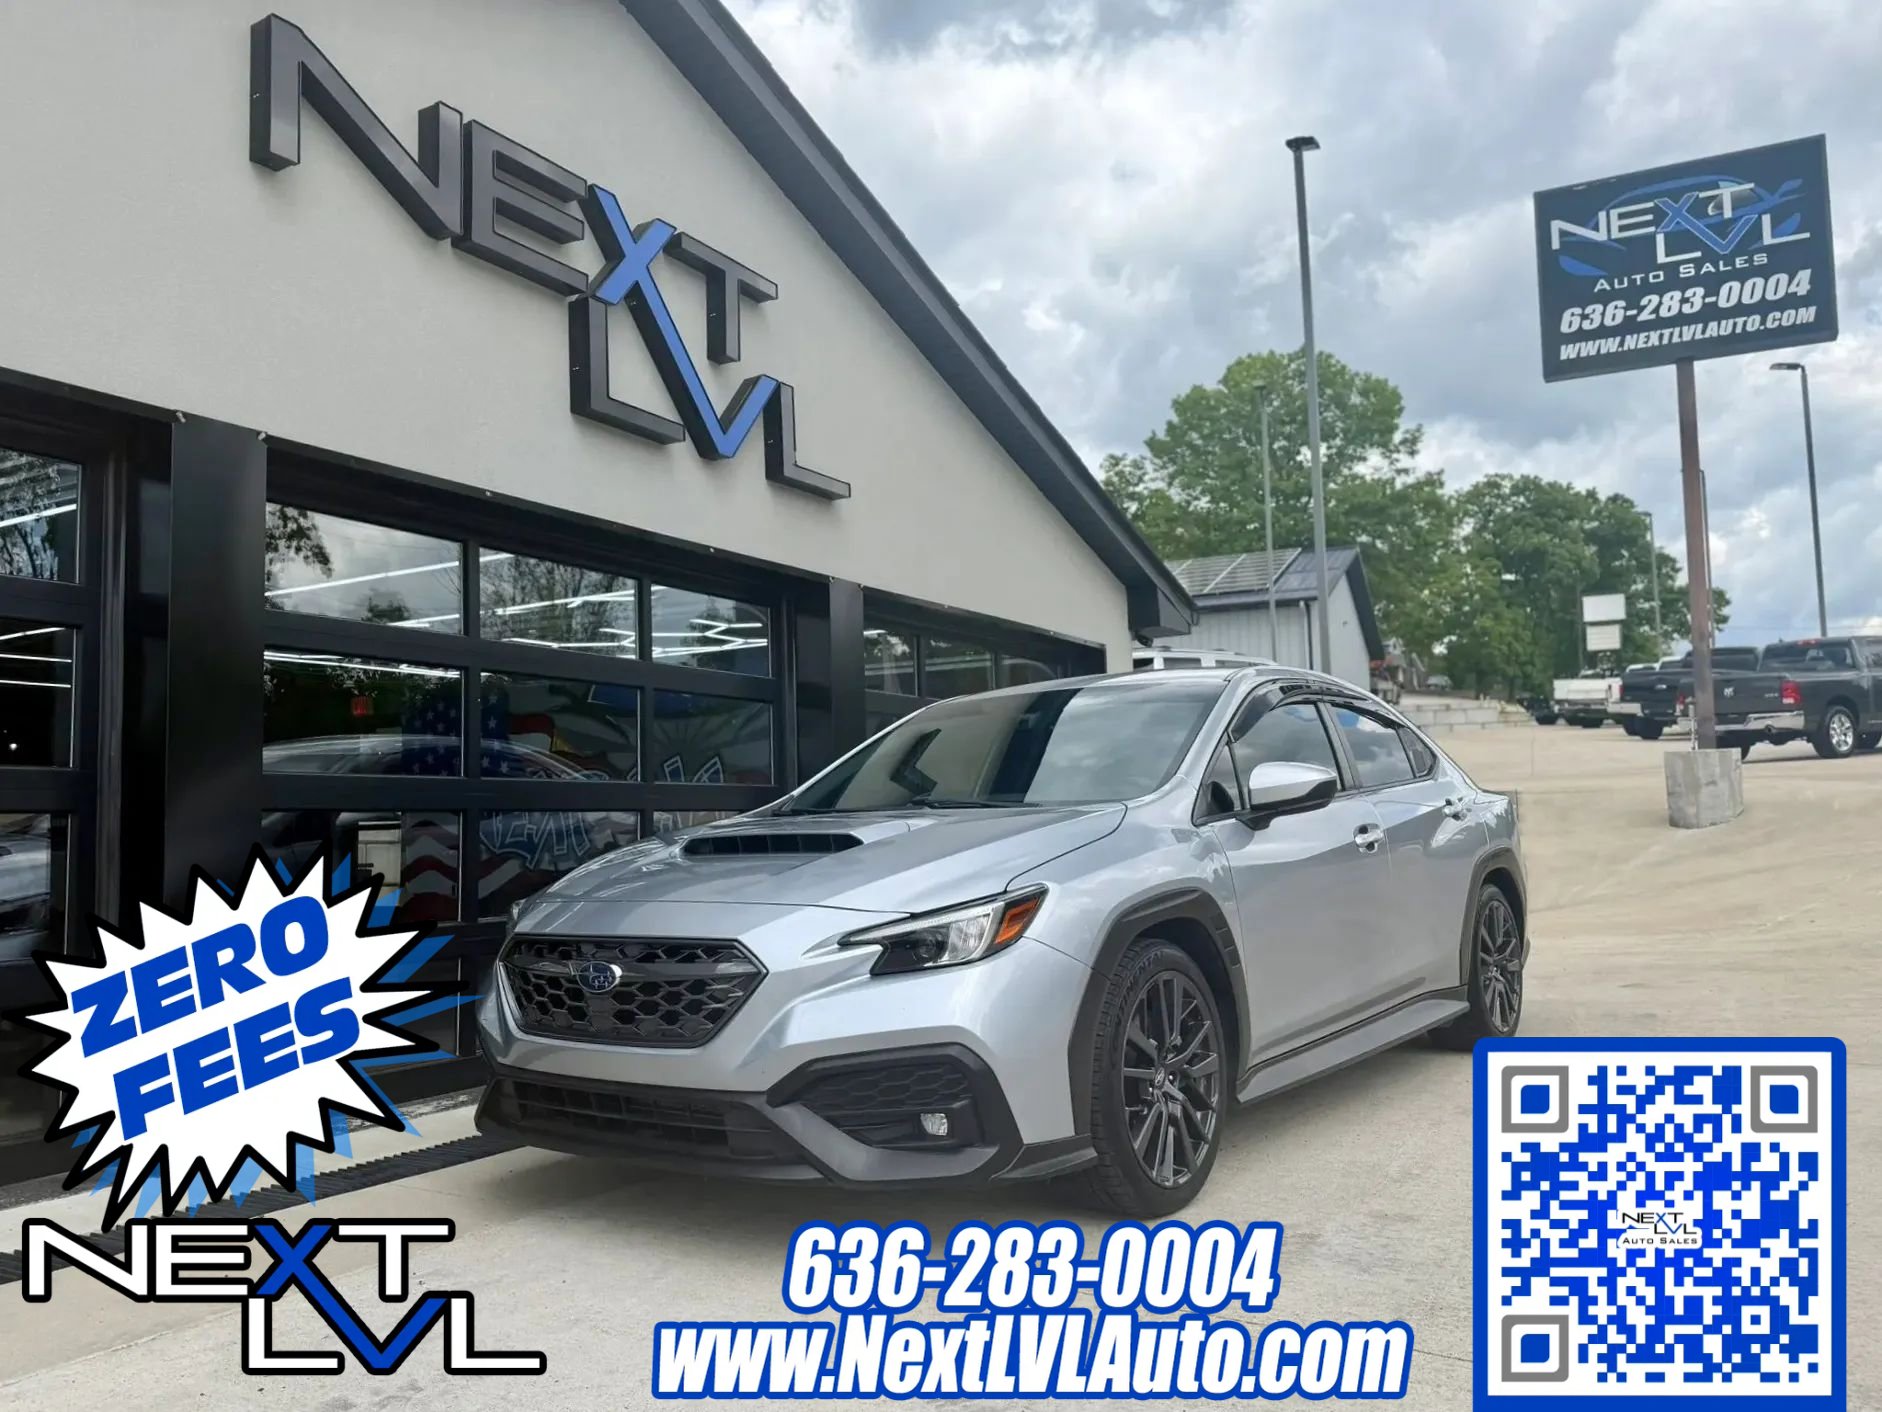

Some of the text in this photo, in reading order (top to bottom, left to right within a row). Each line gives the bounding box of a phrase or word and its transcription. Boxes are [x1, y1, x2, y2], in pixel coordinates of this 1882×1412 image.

[250, 13, 778, 365] NEXT
[1551, 183, 1755, 250] NEXT
[1655, 213, 1811, 264] LVL
[1560, 269, 1812, 333] 636-283-0004
[1560, 306, 1817, 360] WWW.NEXTLVLAUTO.COM
[569, 297, 851, 500] LVL
